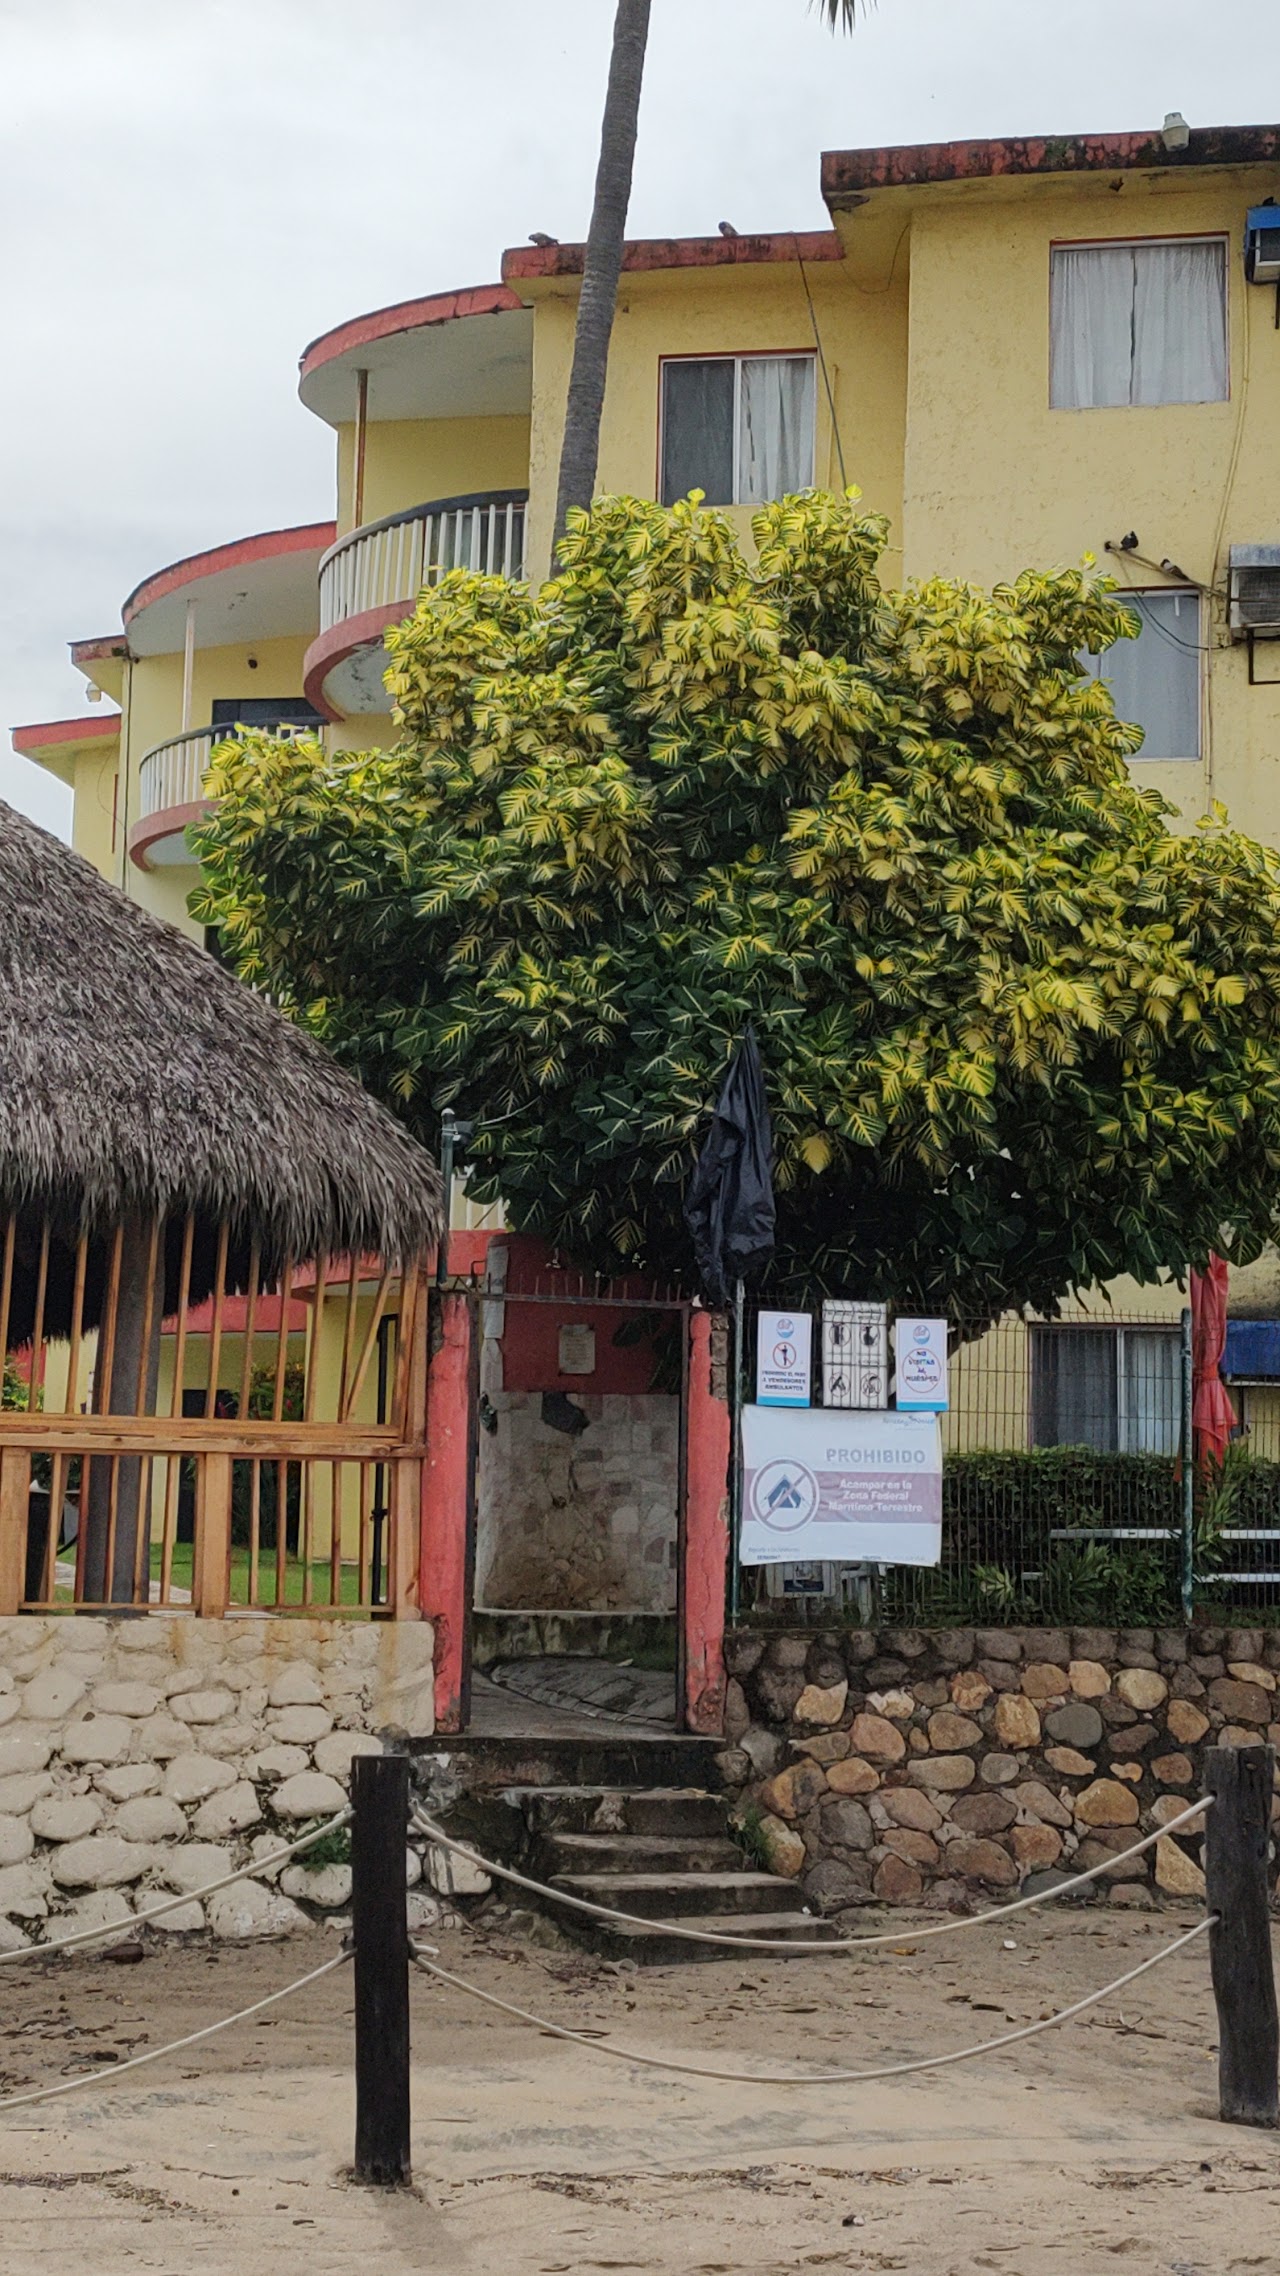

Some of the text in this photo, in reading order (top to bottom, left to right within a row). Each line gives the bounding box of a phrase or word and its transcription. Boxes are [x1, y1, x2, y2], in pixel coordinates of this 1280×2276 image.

[826, 1448, 926, 1464] PROHIBIDO
[839, 1478, 912, 1491] Acampar en la
[842, 1490, 909, 1501] Zona Federal
[875, 1502, 924, 1513] Terrestre
